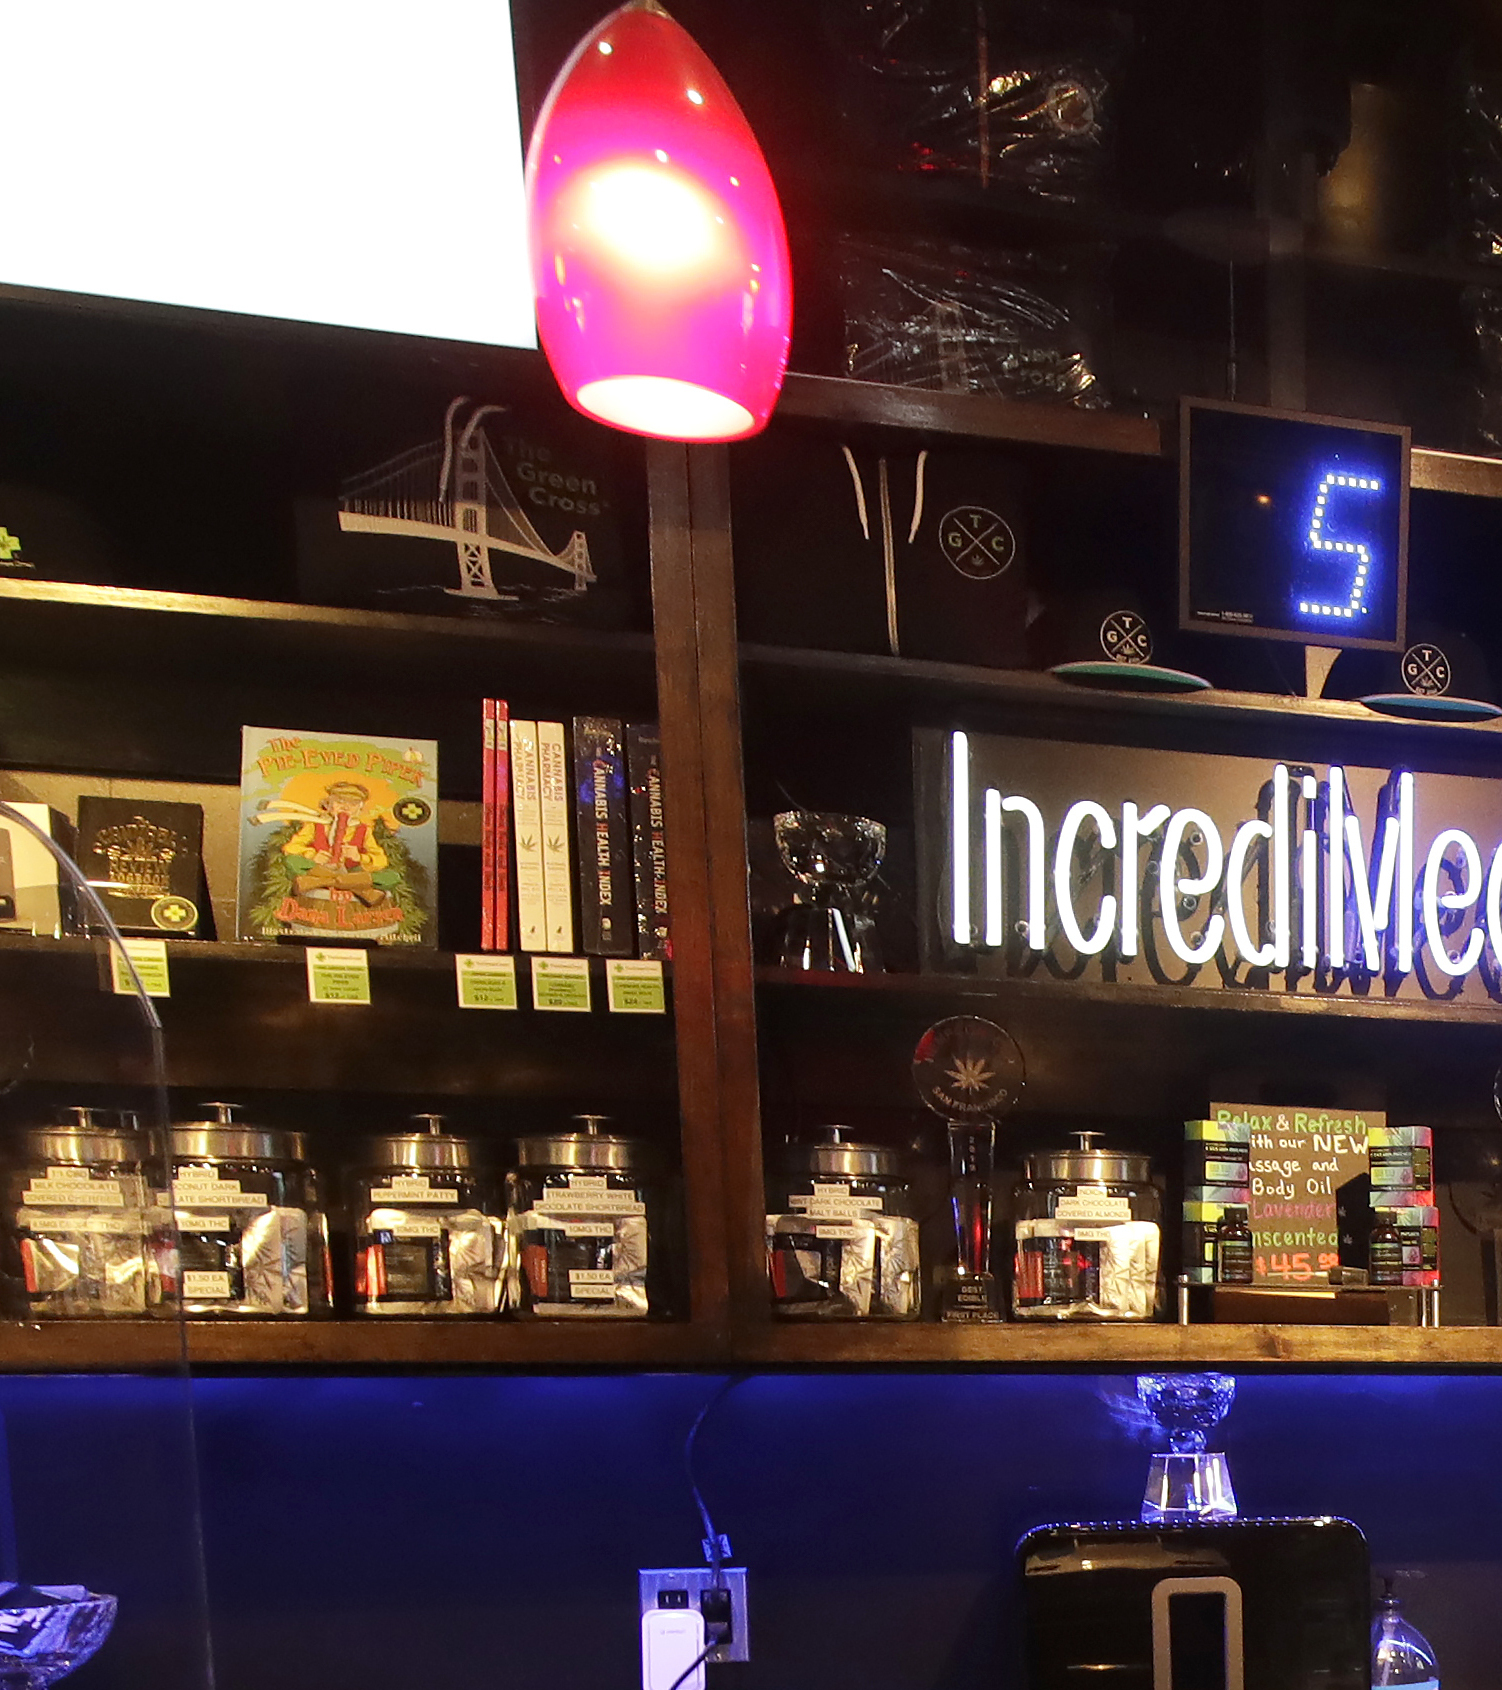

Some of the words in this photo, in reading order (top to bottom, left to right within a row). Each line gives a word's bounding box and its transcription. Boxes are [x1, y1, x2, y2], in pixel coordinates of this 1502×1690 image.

[516, 462, 597, 495] Green
[528, 487, 600, 515] Cross
[1299, 473, 1380, 616] 5
[593, 759, 608, 820] CANNABIS
[647, 768, 663, 828] CANNABIS
[596, 822, 610, 867] HEALTH
[651, 831, 667, 874] HEALTH
[598, 870, 612, 905] INDEX
[653, 878, 668, 914] INDEX
[1276, 1114, 1290, 1131] &
[1294, 1113, 1367, 1134] Refresh
[1251, 1134, 1273, 1149] ith
[1279, 1139, 1306, 1149] our
[1314, 1134, 1368, 1154] NEW
[1312, 1157, 1339, 1172] and
[1252, 1178, 1295, 1200] Body
[1307, 1178, 1331, 1194] Oil
[1252, 1202, 1335, 1219] Lavender
[575, 1287, 610, 1295] SPECIAL
